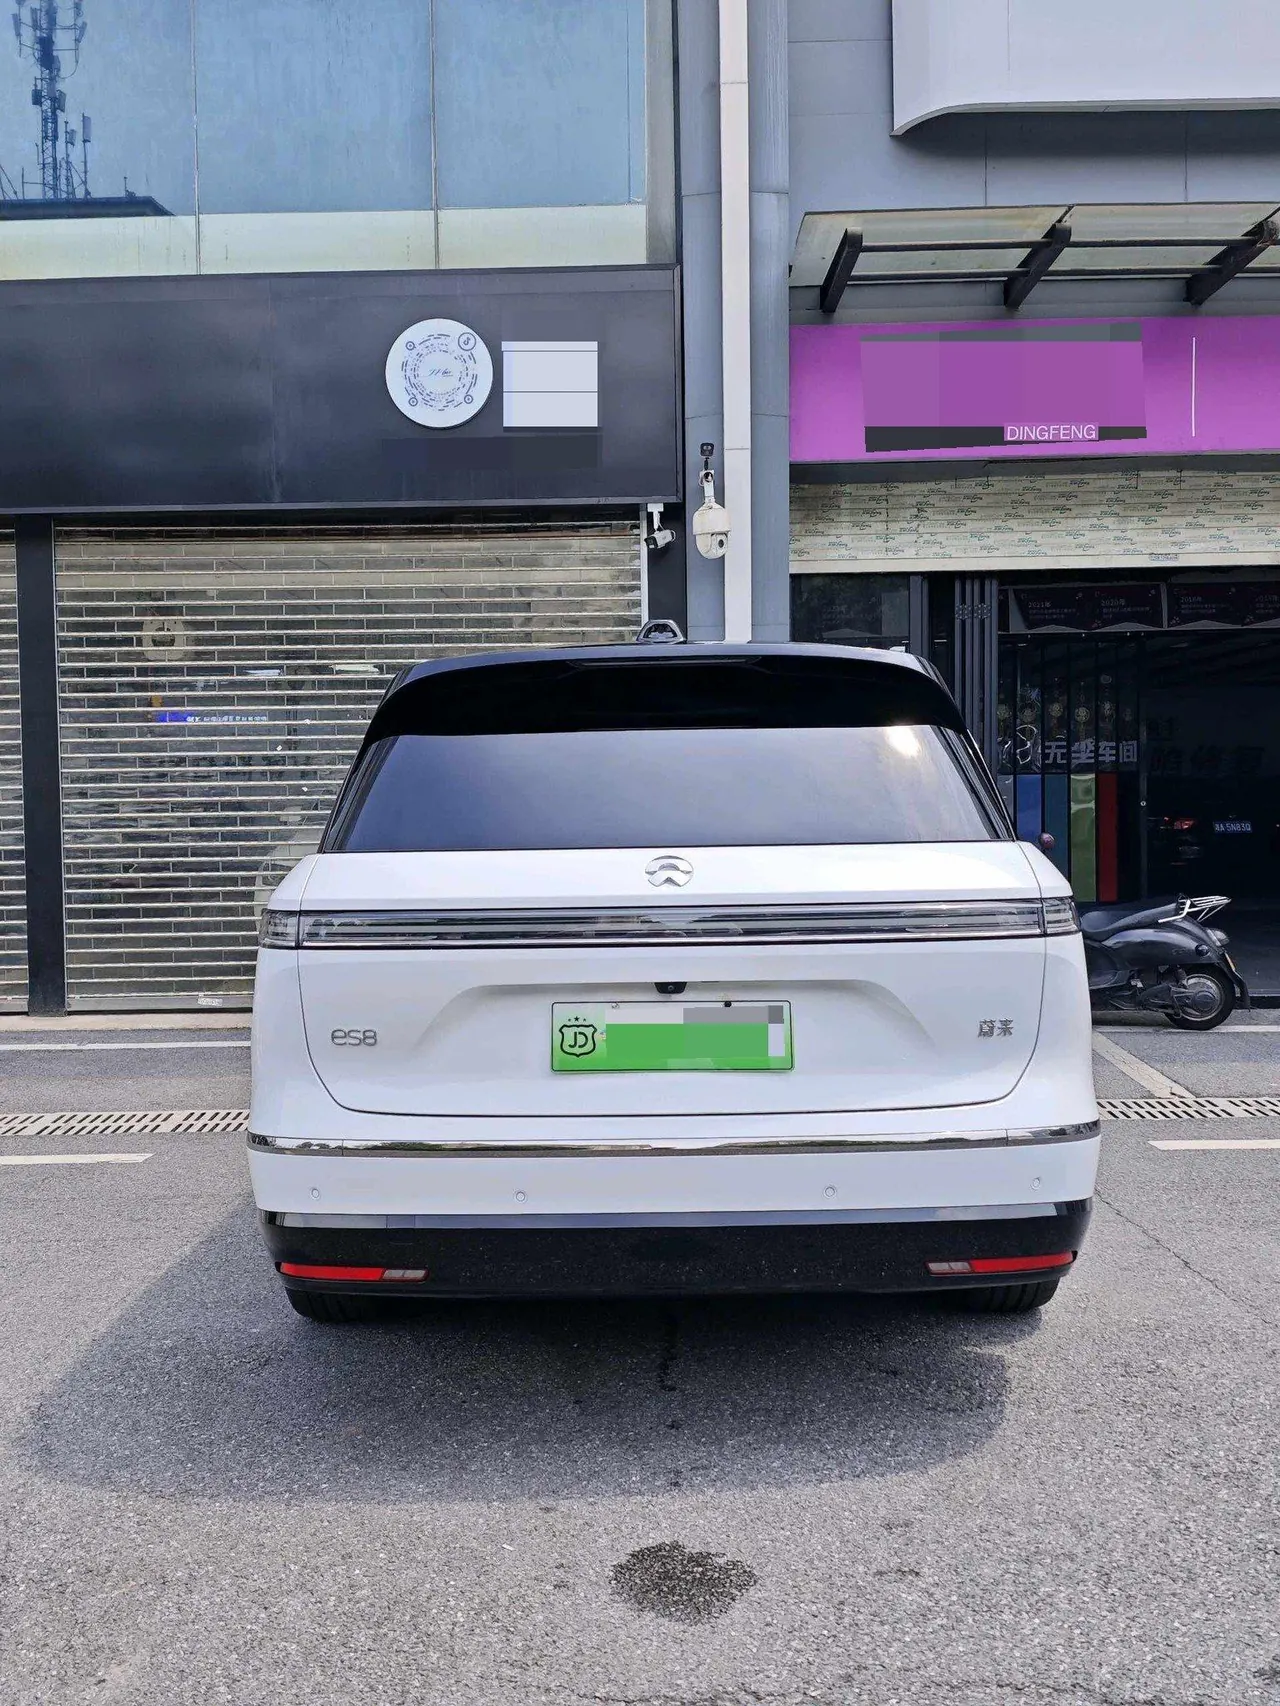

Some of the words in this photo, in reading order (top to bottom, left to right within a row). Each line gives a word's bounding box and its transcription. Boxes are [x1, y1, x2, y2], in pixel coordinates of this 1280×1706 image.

[1007, 424, 1096, 440] DINGFENG
[978, 1018, 1014, 1038] 蔚来
[568, 1031, 589, 1048] JD
